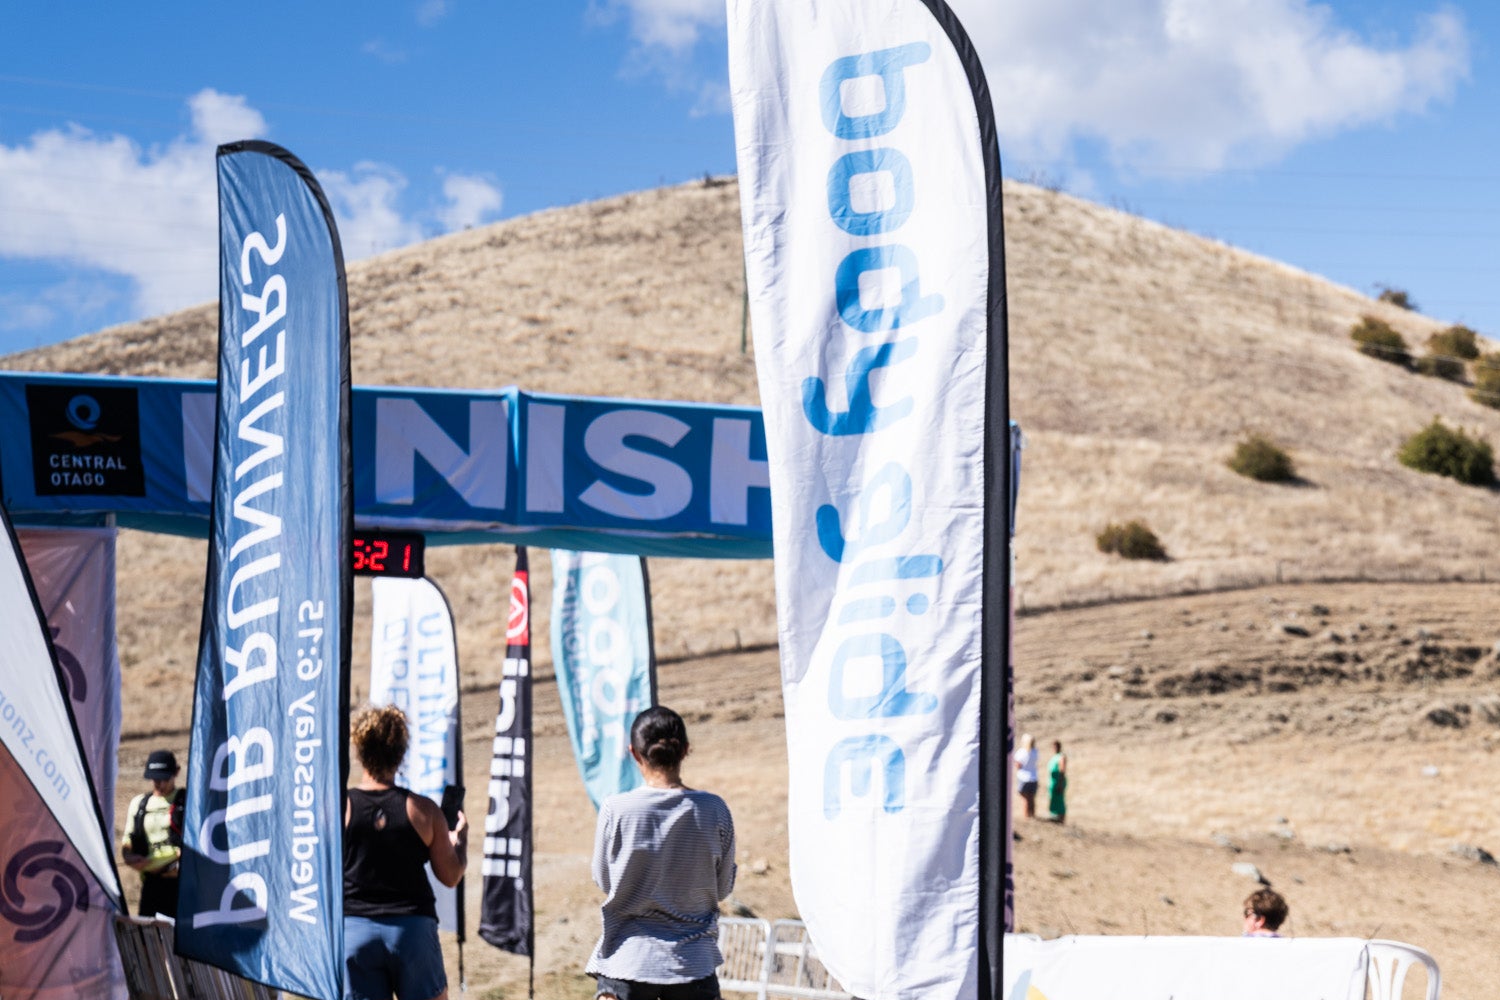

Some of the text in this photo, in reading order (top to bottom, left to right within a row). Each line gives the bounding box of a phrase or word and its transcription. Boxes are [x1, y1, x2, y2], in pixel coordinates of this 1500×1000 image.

[49, 453, 127, 471] CENTRAL
[51, 472, 105, 487] OTAGO
[181, 392, 771, 526] NISH
[0, 694, 71, 801] onz.com
[417, 611, 450, 801] ULTIMAT
